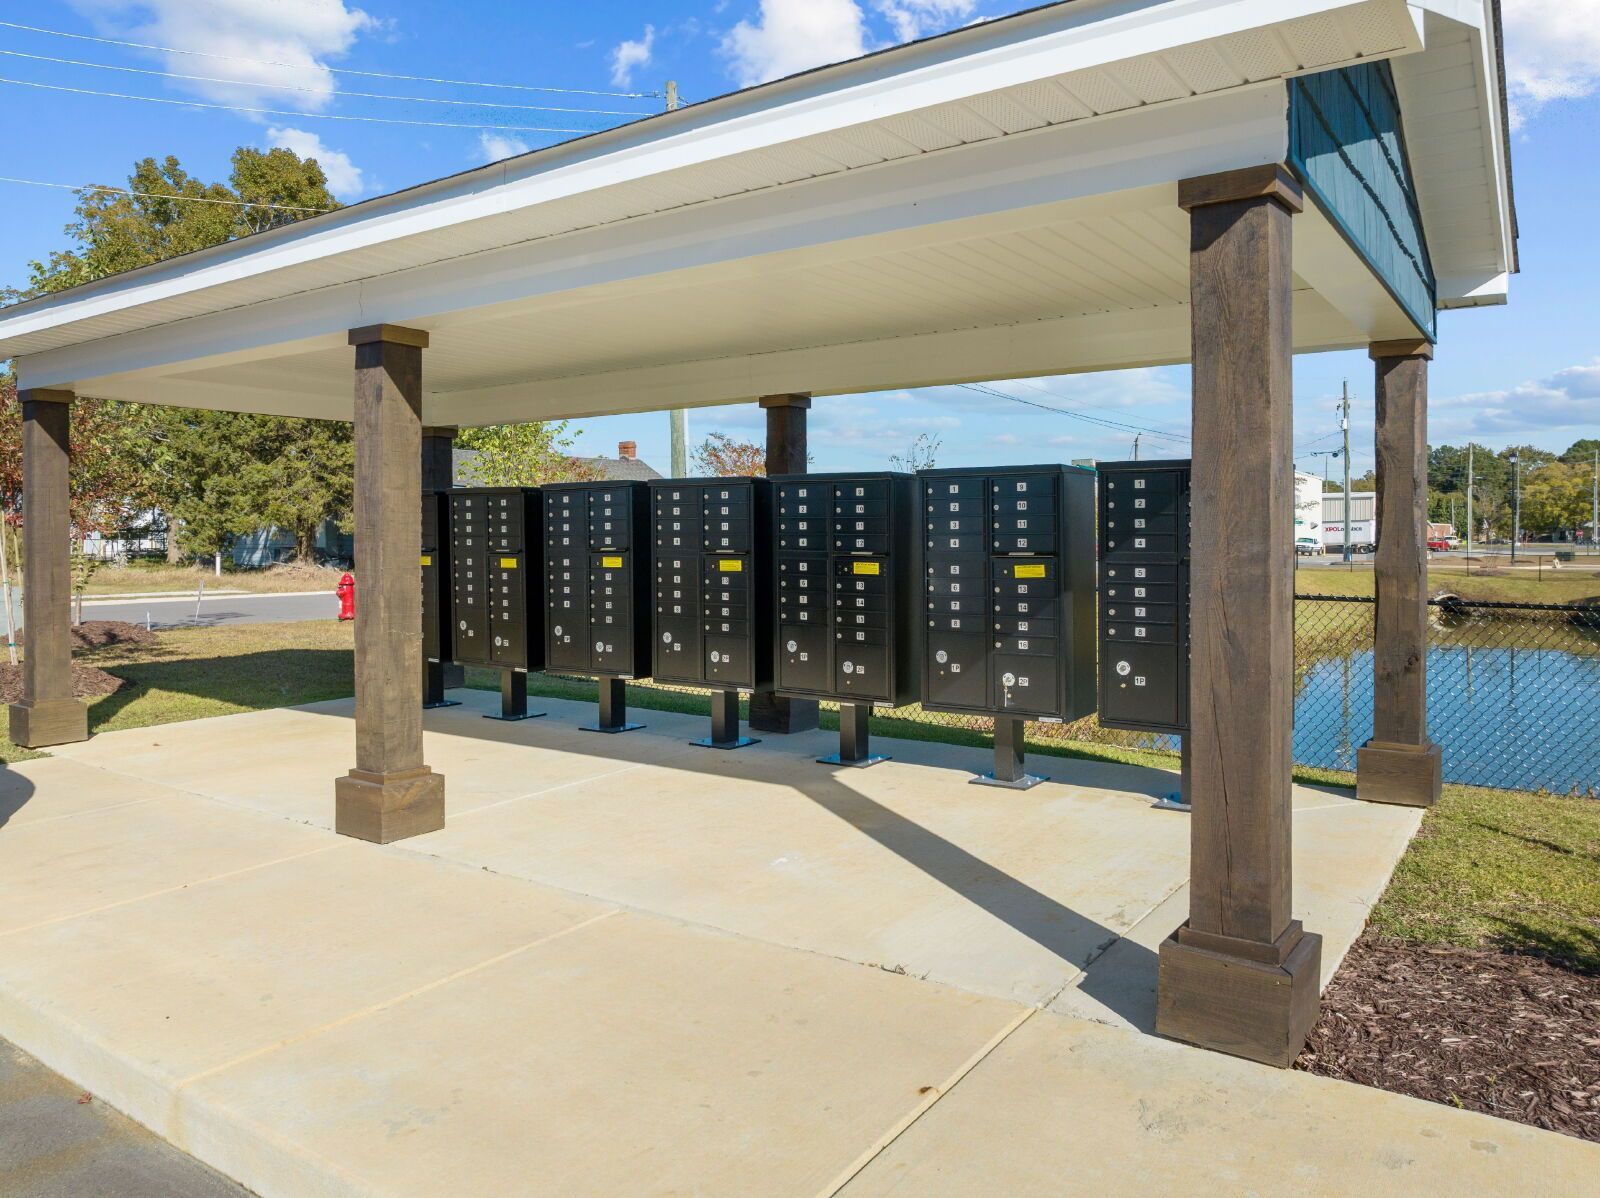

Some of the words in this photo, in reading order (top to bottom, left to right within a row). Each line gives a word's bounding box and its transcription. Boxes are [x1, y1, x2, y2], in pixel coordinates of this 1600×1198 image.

[1017, 502, 1027, 510] 10
[1019, 604, 1027, 612] 14
[1018, 622, 1028, 630] 15
[1018, 640, 1028, 648] 16
[1135, 677, 1145, 685] 1P
